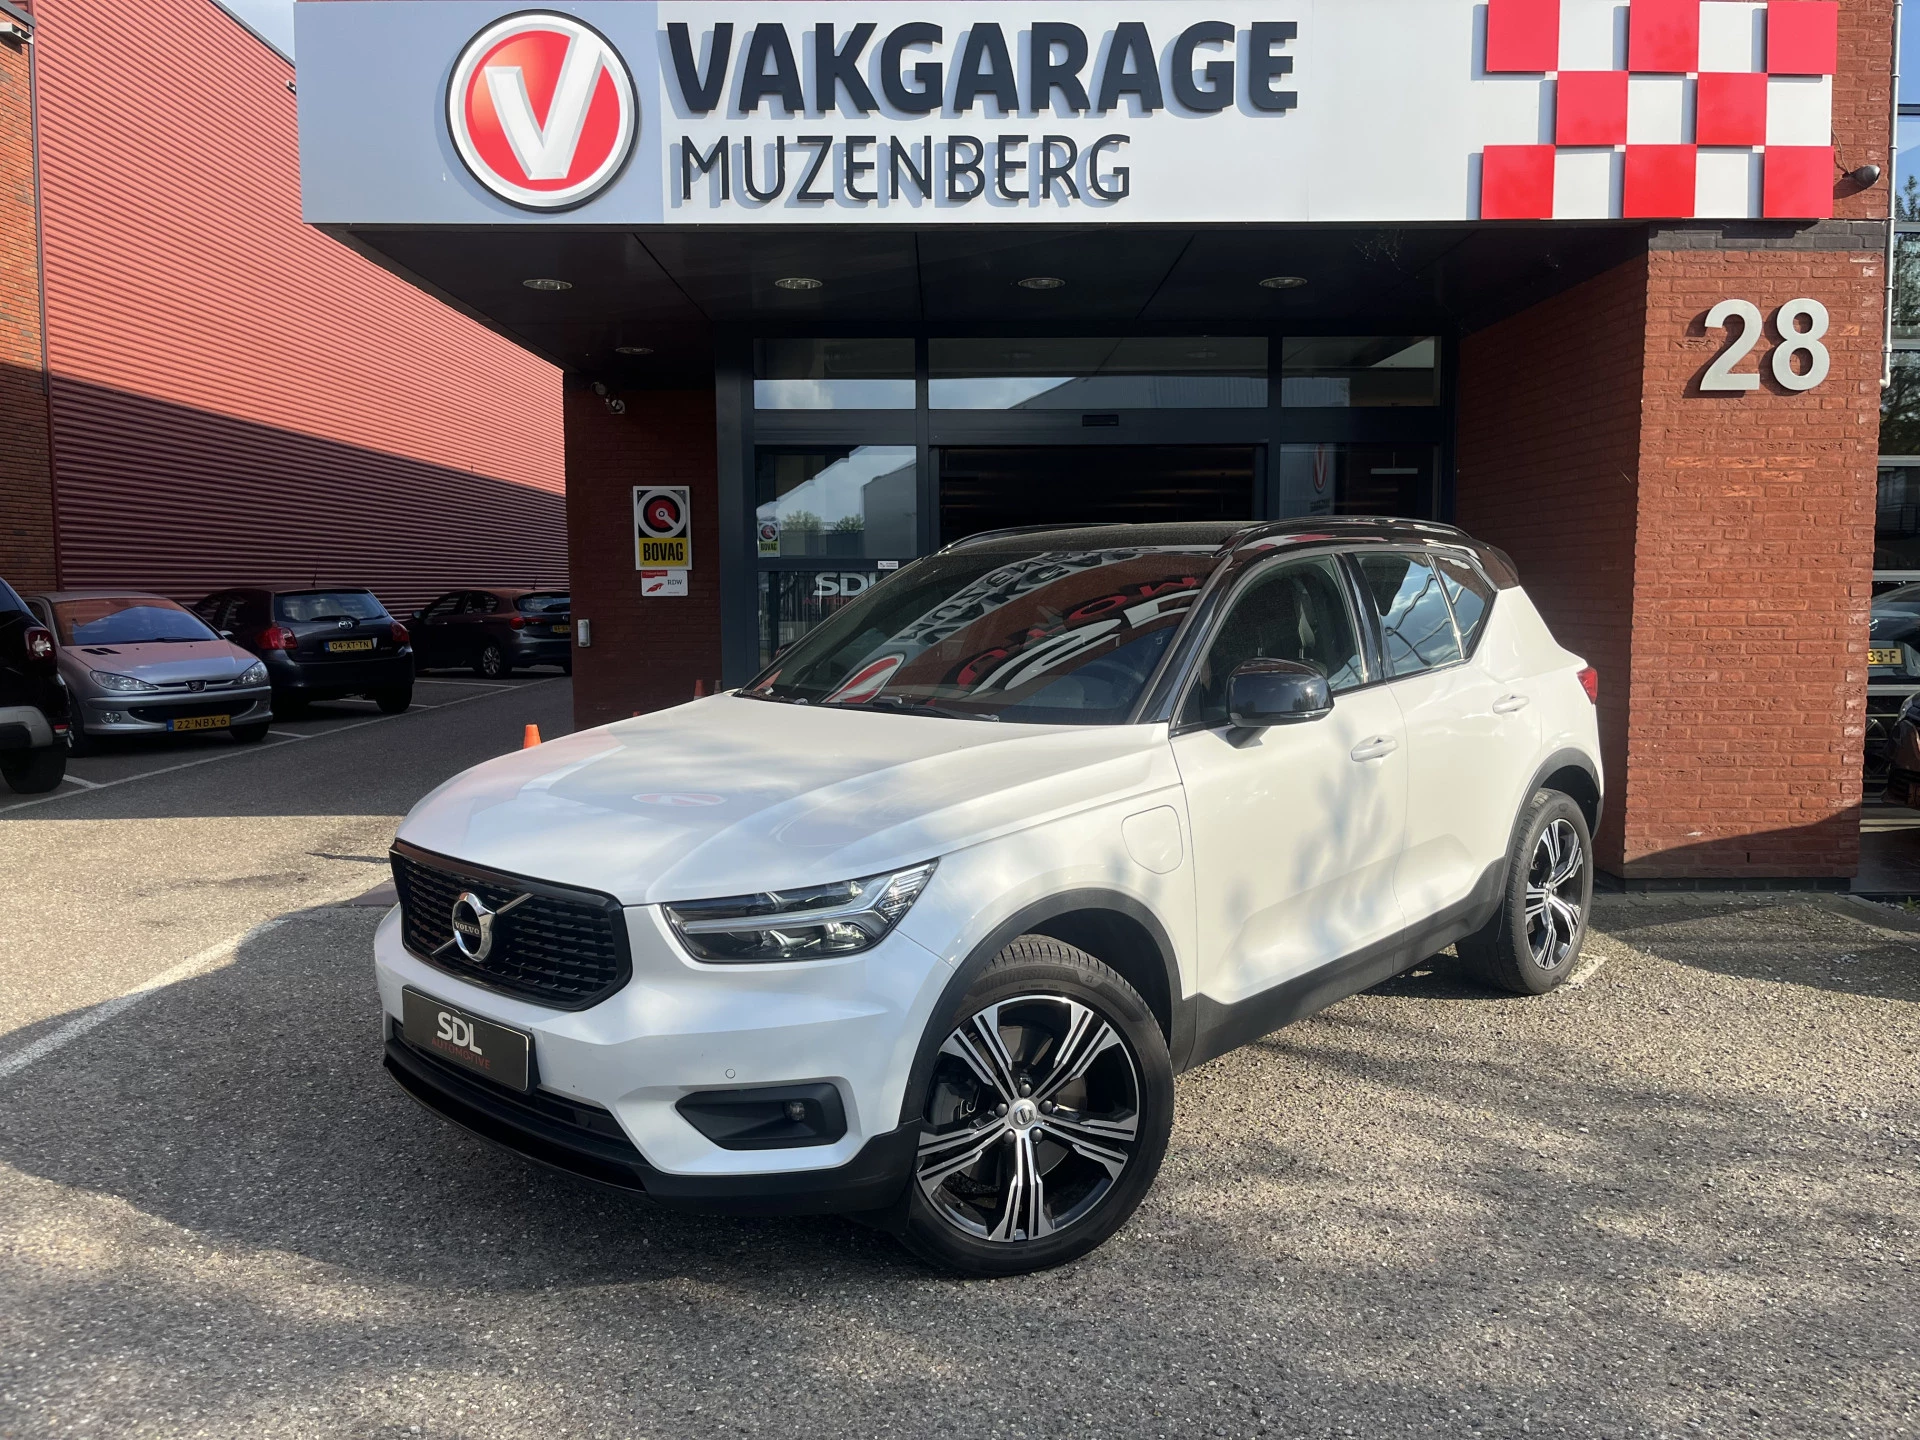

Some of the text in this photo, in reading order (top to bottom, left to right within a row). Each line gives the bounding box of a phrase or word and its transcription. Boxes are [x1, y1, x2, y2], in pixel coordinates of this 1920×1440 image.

[666, 20, 1298, 111] VAKGARAGE
[681, 134, 1131, 201] MUZENBERG
[1700, 297, 1830, 391] 28
[643, 542, 684, 561] BOVAG
[331, 641, 369, 650] 04-XT-TN
[176, 716, 227, 730] 22-NBX-6
[454, 921, 480, 935] VOLVO
[436, 1011, 483, 1056] SDL
[431, 1036, 491, 1070] AUTOMOTIVE
